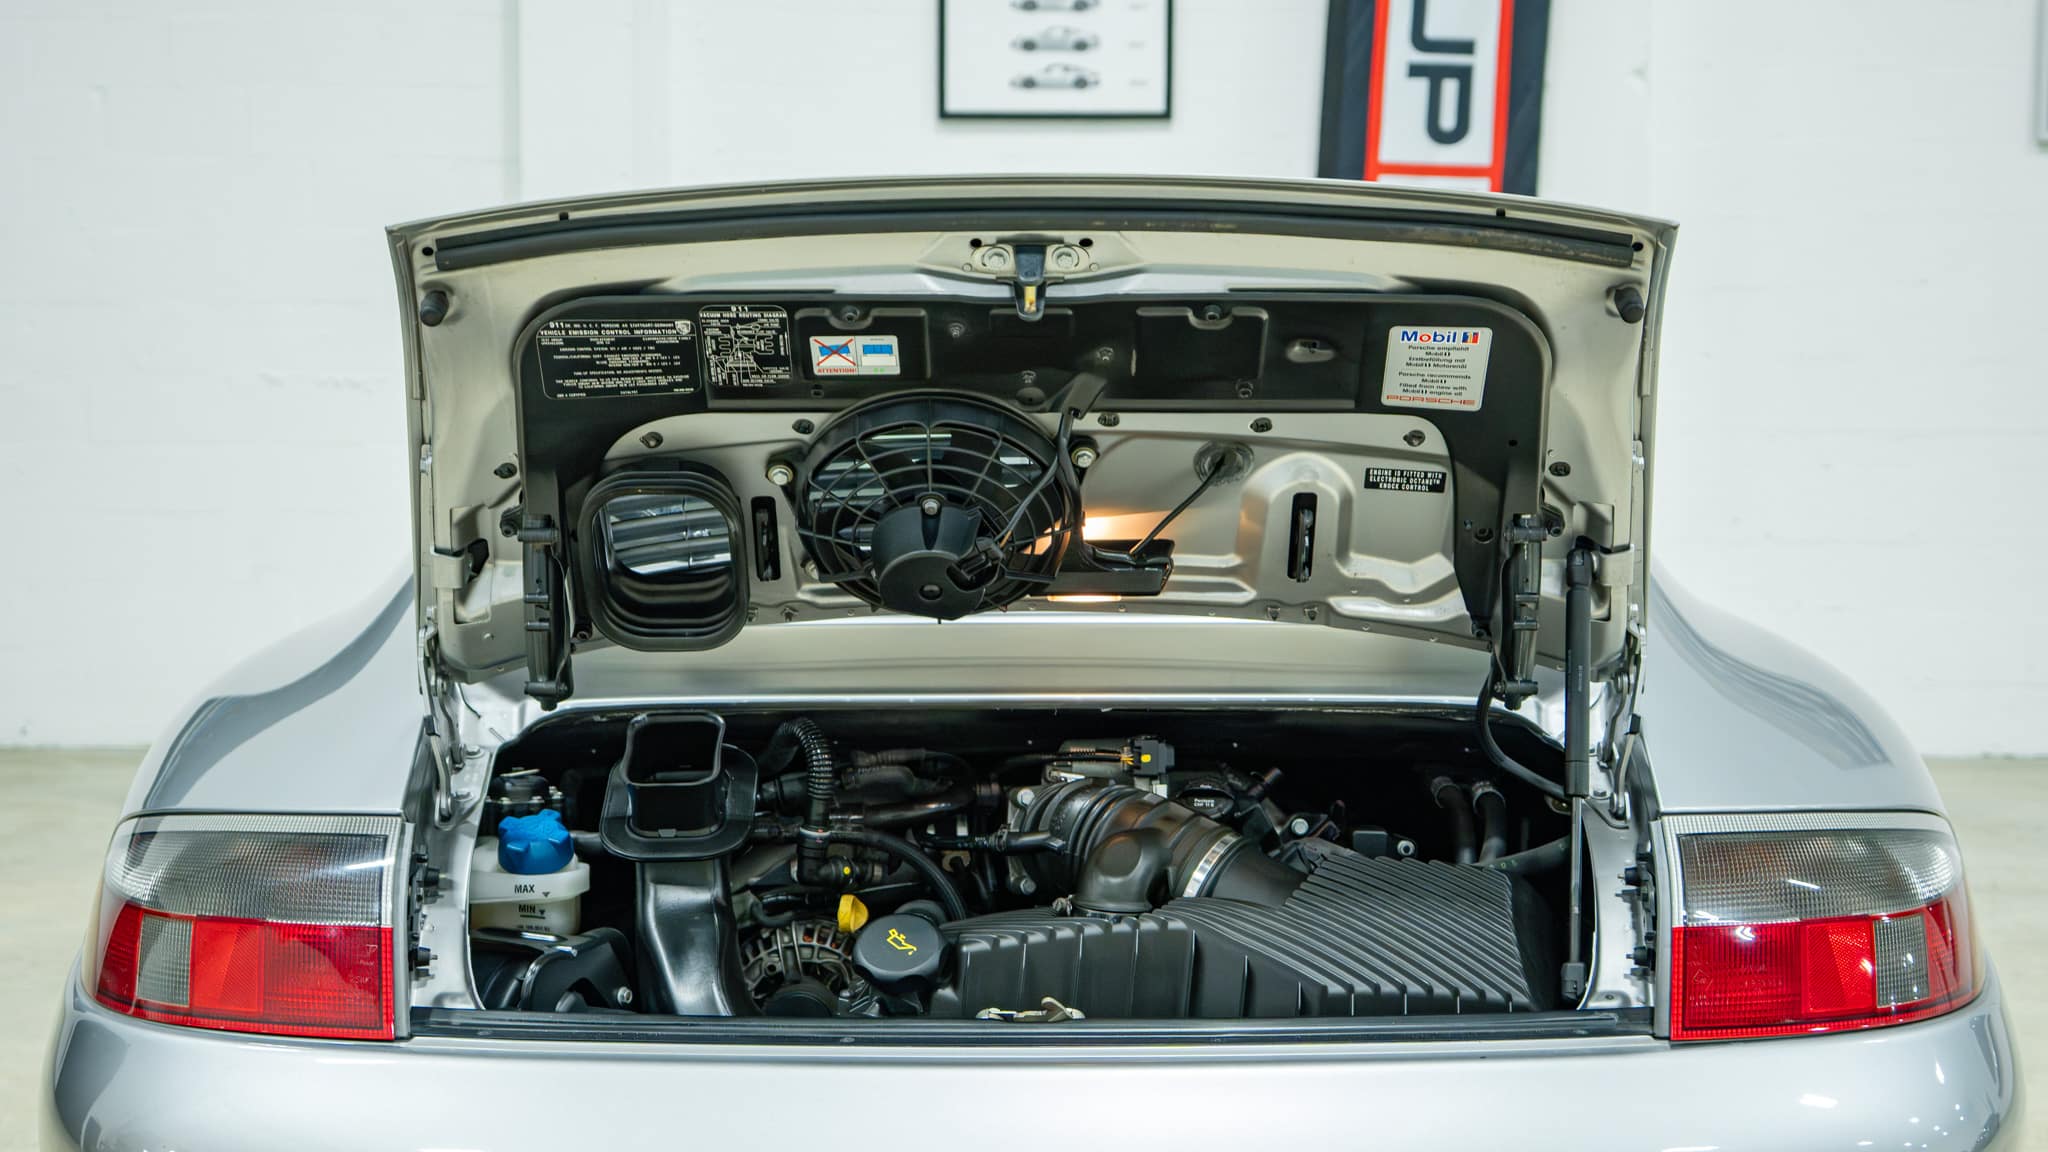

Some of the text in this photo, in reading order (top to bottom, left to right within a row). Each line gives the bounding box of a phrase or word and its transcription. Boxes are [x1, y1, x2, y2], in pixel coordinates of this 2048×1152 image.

[1401, 331, 1457, 343] Mobil
[1403, 470, 1425, 478] FITTED
[1370, 476, 1408, 484] ELECTRONIC
[514, 884, 535, 894] MAX
[518, 904, 536, 913] MIN
